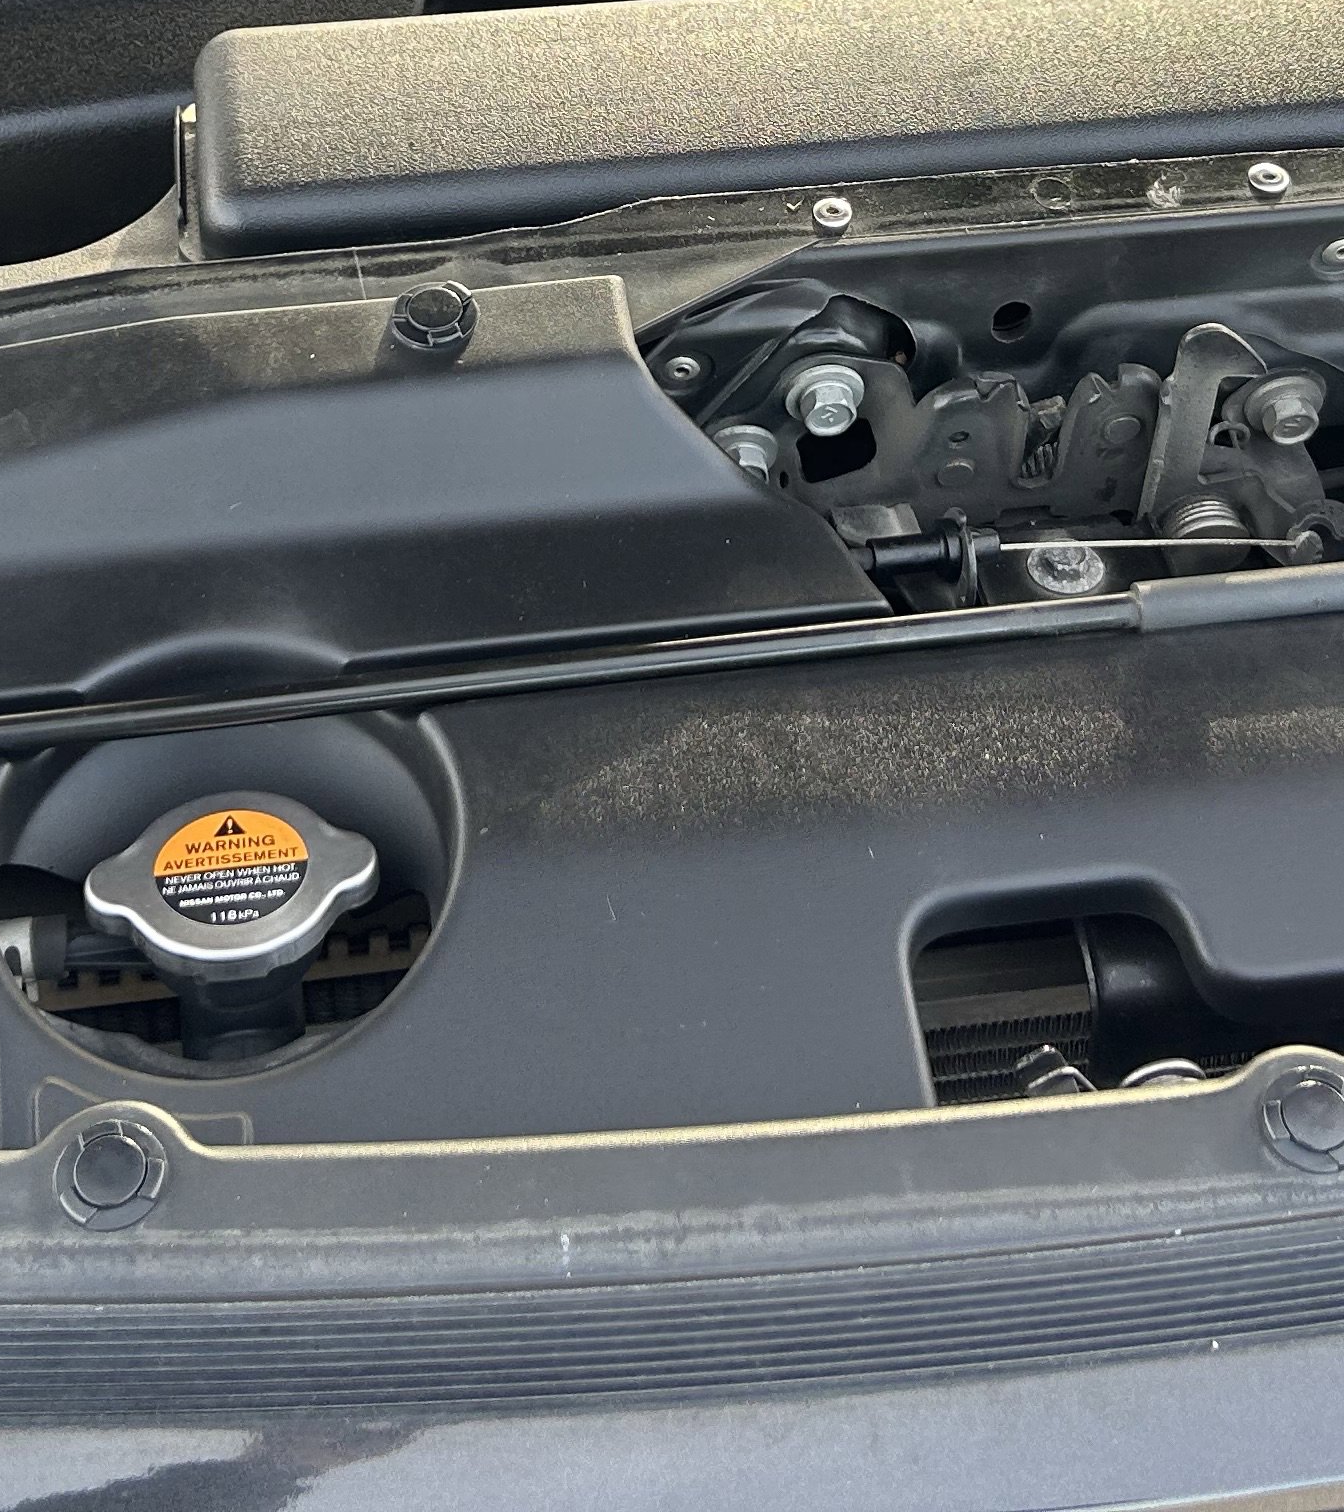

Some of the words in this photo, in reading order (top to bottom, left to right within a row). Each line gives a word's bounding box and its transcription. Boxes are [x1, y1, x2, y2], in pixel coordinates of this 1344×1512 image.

[185, 834, 276, 855] WARNING
[163, 846, 299, 872] AVERTISSEMENT
[165, 872, 202, 885] NEVER
[203, 869, 235, 880] OPEN
[237, 865, 271, 877] WHEN
[162, 886, 177, 896] NE
[178, 880, 214, 894] JAMAIS
[214, 877, 254, 889] OUVRIR
[179, 896, 214, 908] NISSAN
[214, 892, 247, 904] MOTOR
